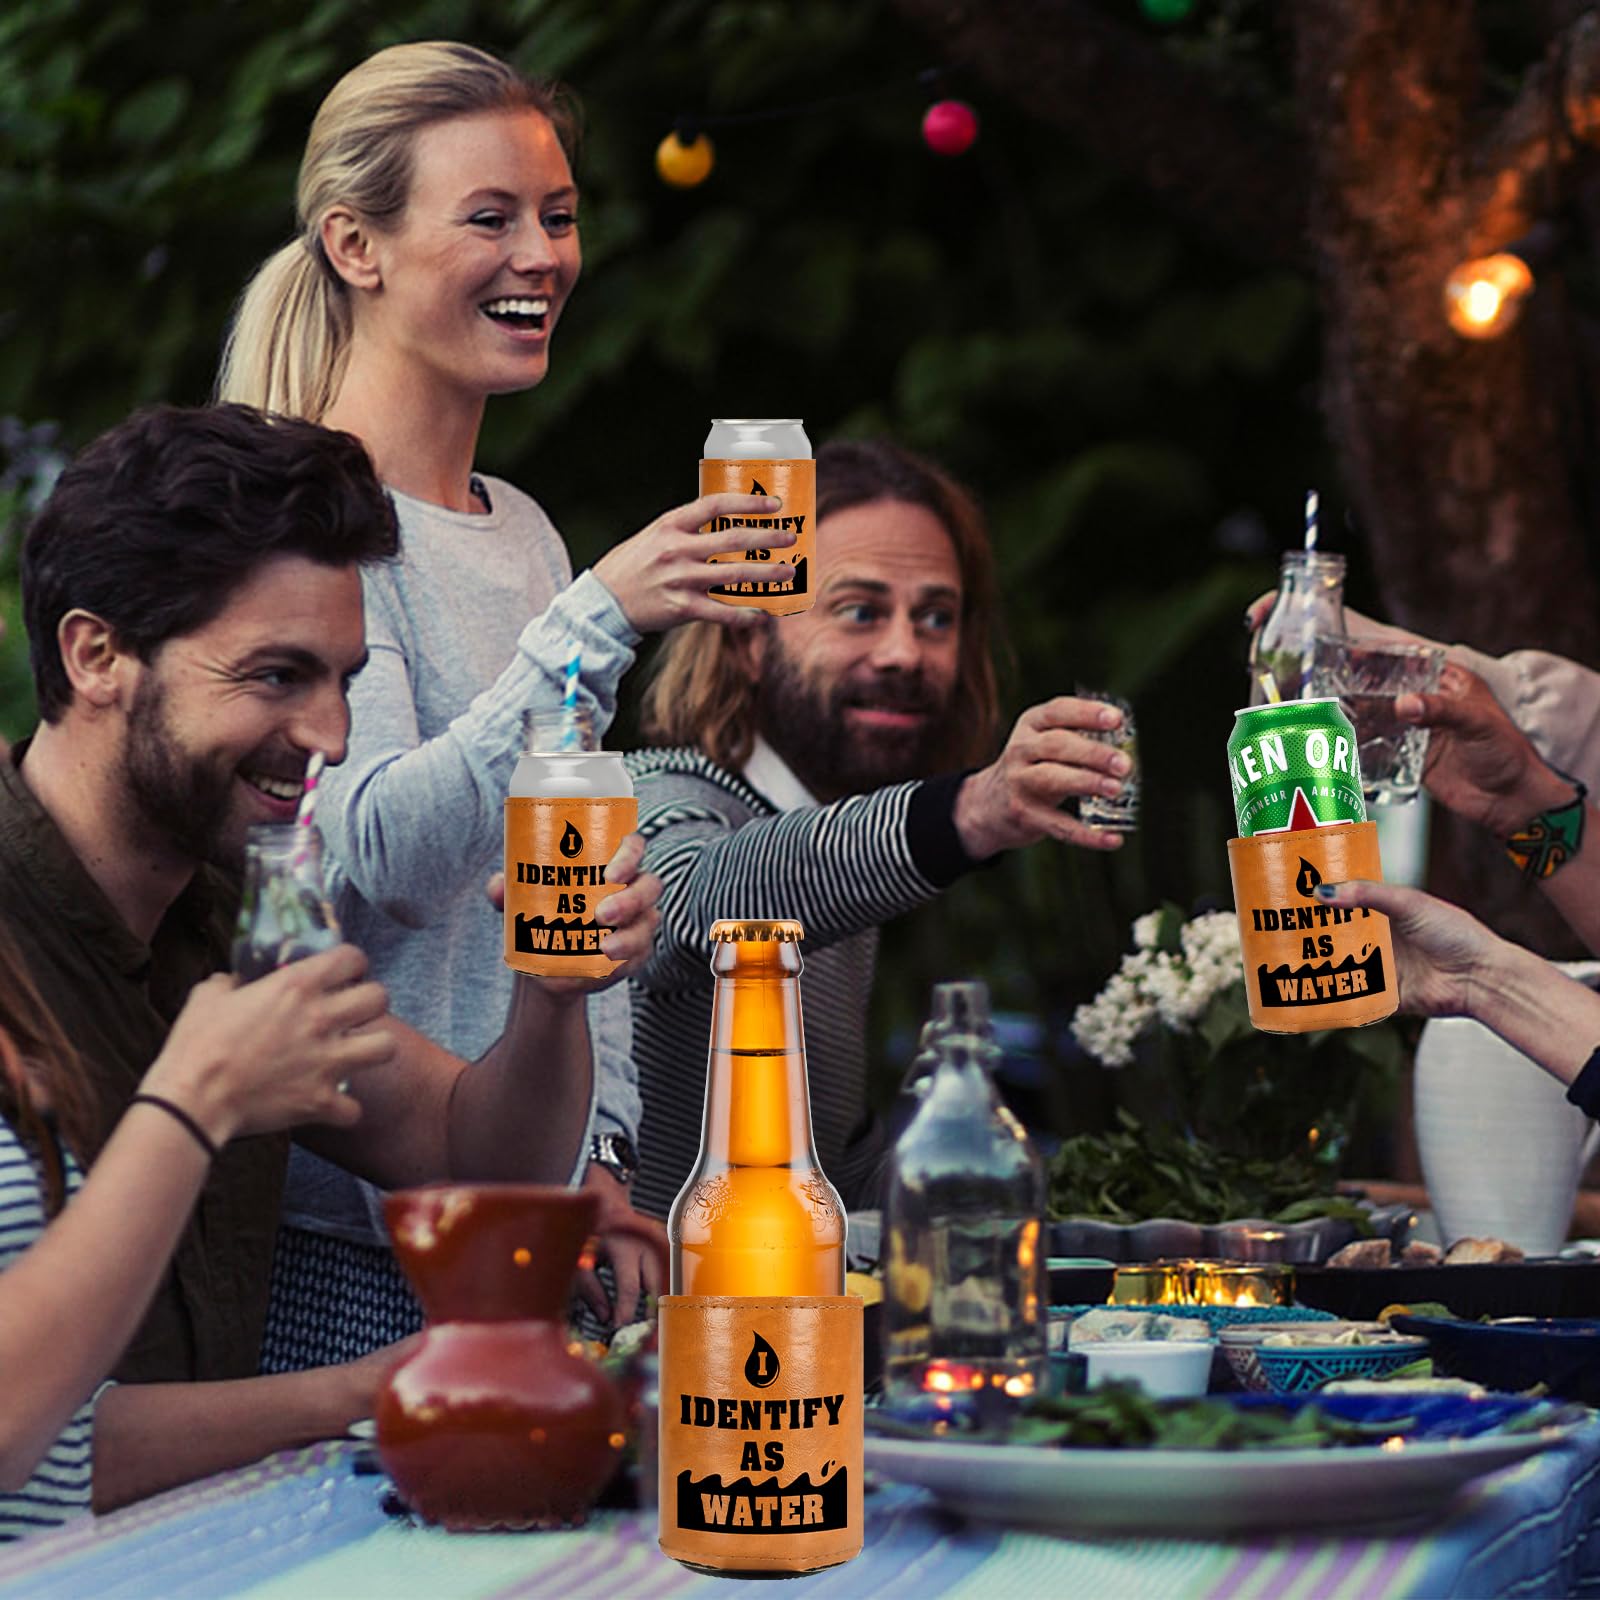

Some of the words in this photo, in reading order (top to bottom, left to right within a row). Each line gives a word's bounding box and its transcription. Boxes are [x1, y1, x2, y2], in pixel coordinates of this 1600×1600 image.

[745, 548, 771, 561] AS
[568, 833, 576, 850] I
[1303, 870, 1314, 889] I
[557, 894, 586, 914] AS
[1302, 935, 1334, 960] AS
[1276, 969, 1368, 1001] WATER
[757, 1351, 768, 1376] I
[680, 1394, 845, 1431] IDENTIFY
[740, 1441, 785, 1472] AS
[700, 1494, 825, 1527] WATER
